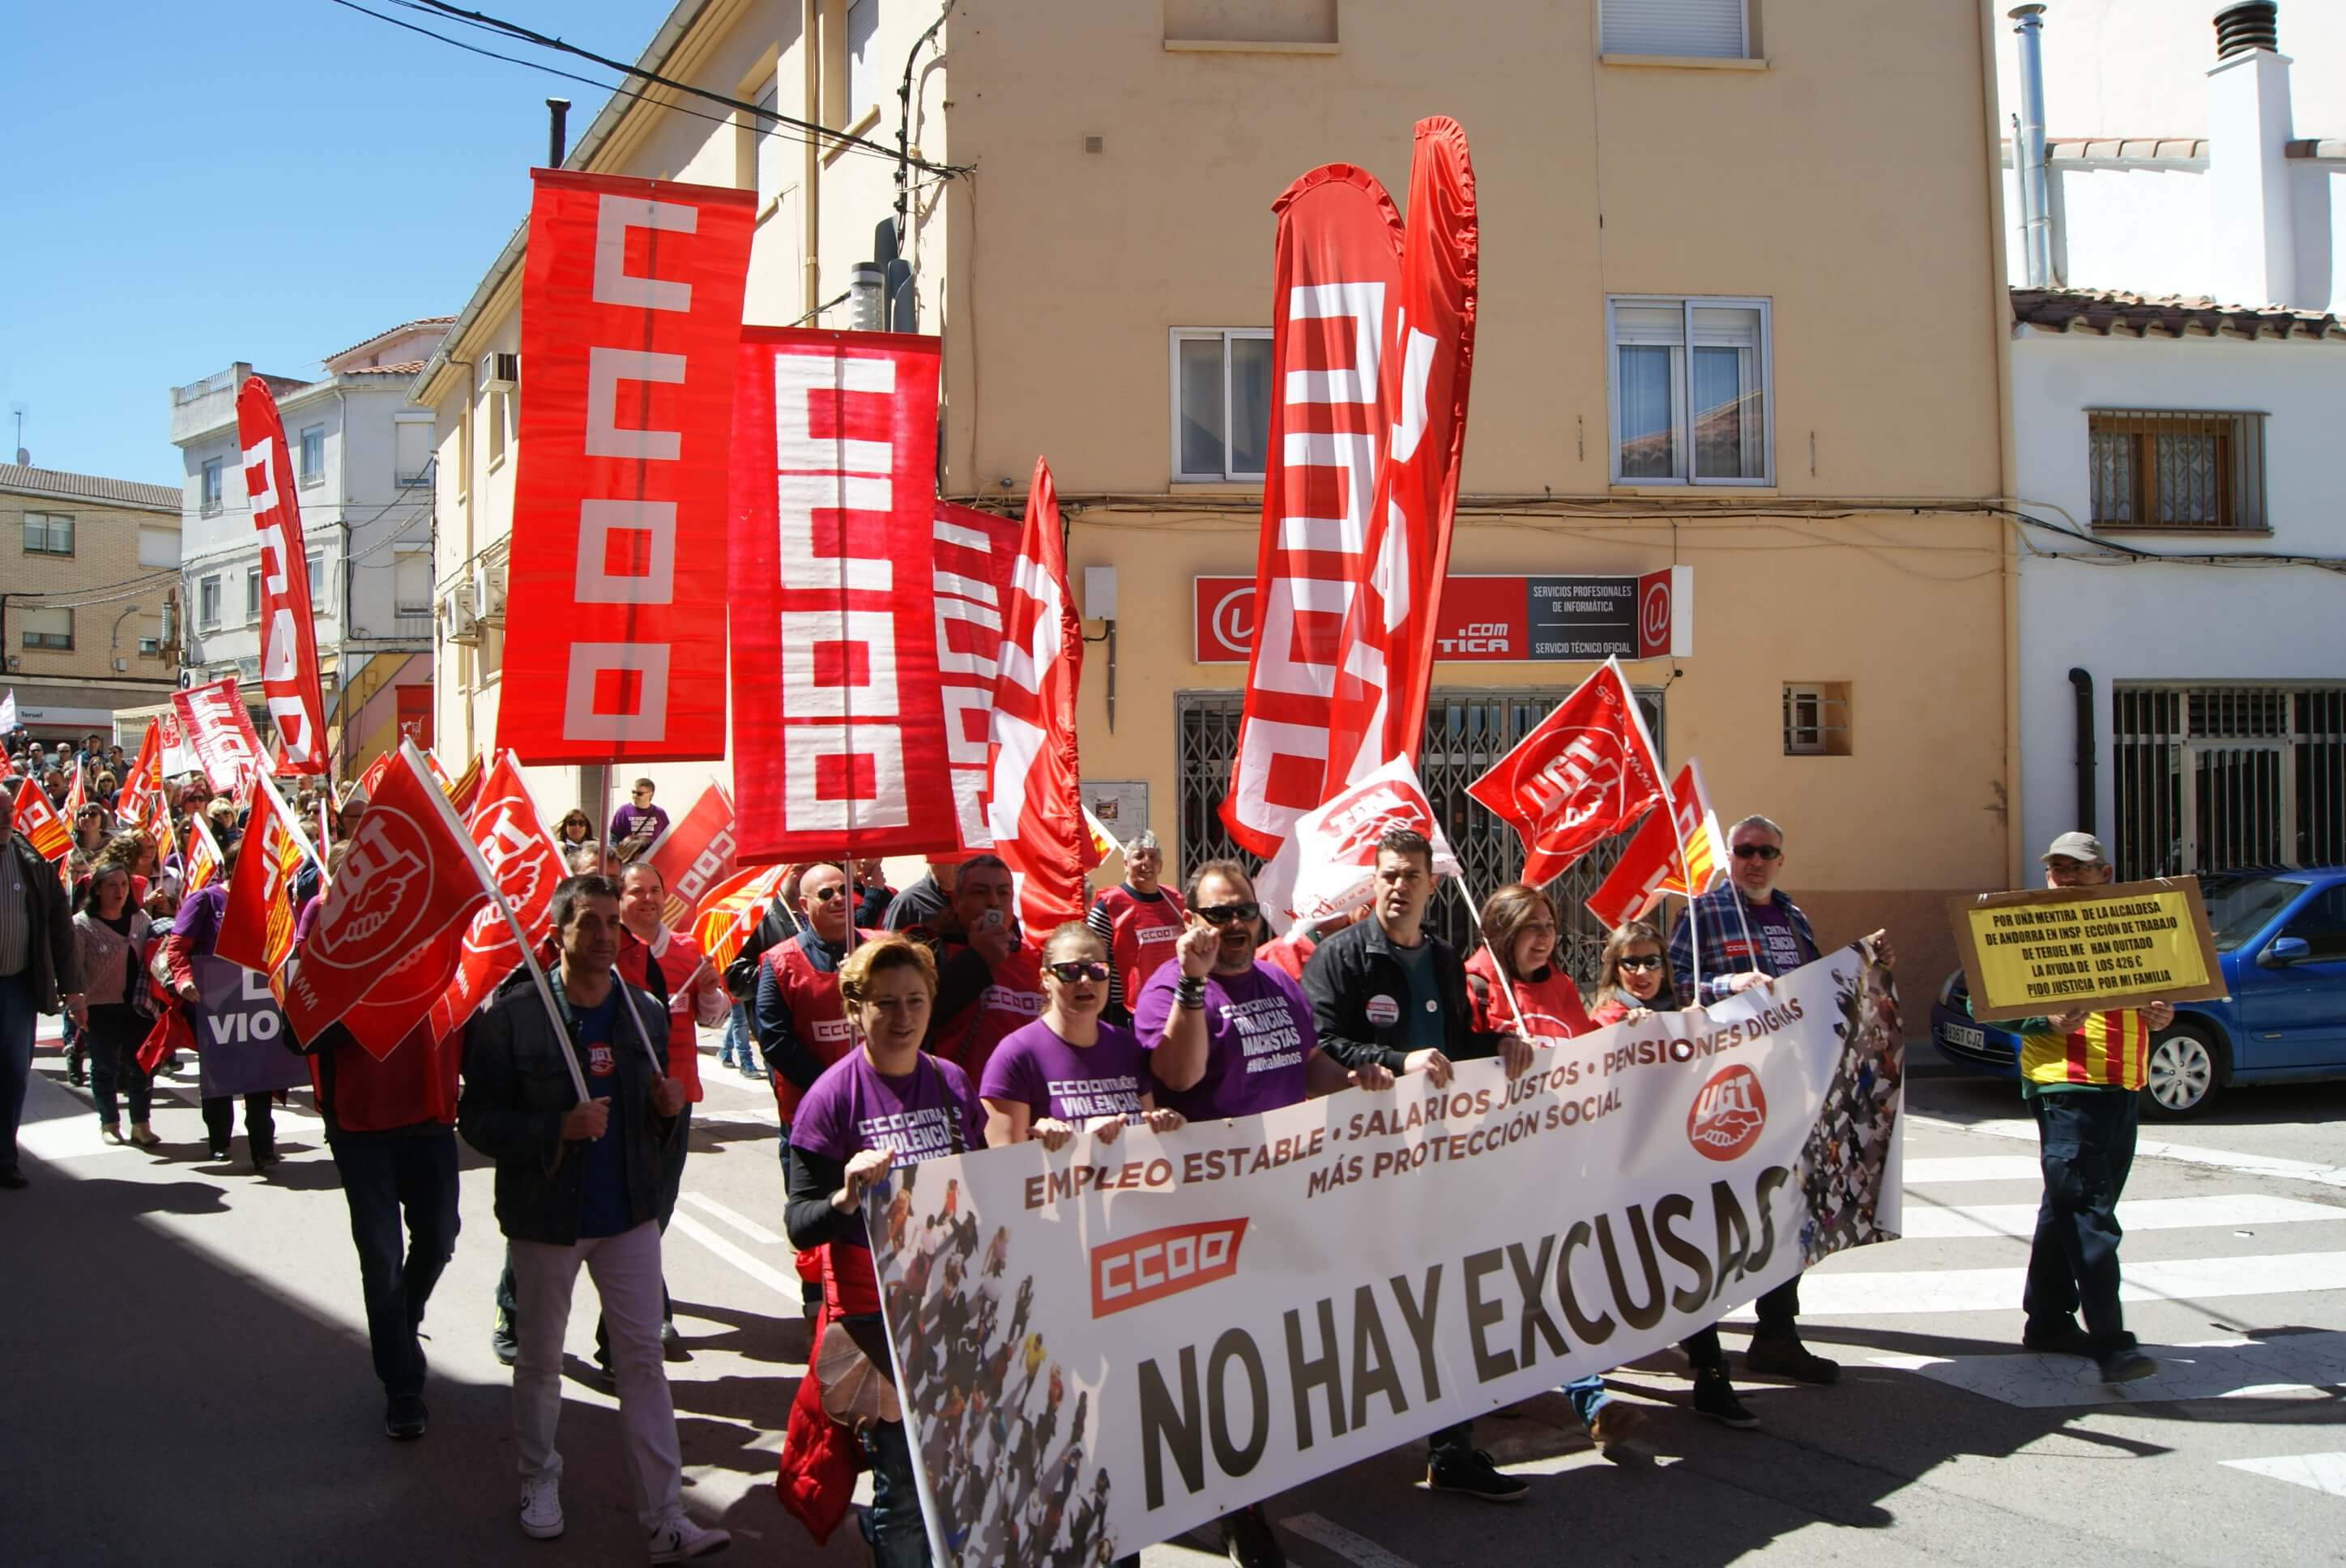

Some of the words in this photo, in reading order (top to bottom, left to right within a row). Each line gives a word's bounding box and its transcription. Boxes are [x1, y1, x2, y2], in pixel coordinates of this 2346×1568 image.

[565, 194, 698, 744] CCOO
[774, 354, 910, 832] CCOO
[1533, 586, 1572, 598] SERVICIOS
[1573, 585, 1632, 598] PROFESIONALES
[1552, 602, 1563, 612] DE
[1563, 599, 1614, 613] INFORMÁTICA
[1535, 642, 1569, 654] SERVICIO
[1570, 640, 1602, 654] TÉCNICO
[1603, 641, 1632, 654] OFICIAL
[1520, 735, 1601, 816] UGT
[477, 807, 537, 881] GT
[1993, 914, 2014, 928] POR
[2015, 912, 2034, 927] UNA
[2034, 909, 2078, 925] MENTIRA
[2082, 907, 2096, 921] DE
[2096, 906, 2109, 920] LA
[2109, 901, 2162, 919] ALCALDESA
[1141, 929, 1171, 940] CCOO
[1986, 933, 1999, 946] DE
[1999, 929, 2045, 945] ANDORRA
[2046, 927, 2058, 941] EN
[2058, 926, 2082, 940] INSP
[2084, 921, 2121, 938] ECCIÓN
[2122, 921, 2135, 935] DE
[2135, 916, 2178, 932] TRABAJO
[2022, 948, 2034, 961] DE
[2034, 944, 2069, 960] TERUEL
[2071, 942, 2085, 957] ME
[2091, 940, 2111, 955] HAN
[2113, 936, 2154, 953] QUITADO
[2032, 964, 2045, 978] LA
[2045, 961, 2075, 977] AYUDA
[2076, 961, 2090, 974] DE
[2096, 957, 2114, 972] LOS
[2116, 956, 2135, 970] 426
[2027, 982, 2050, 996] PIDO
[2051, 978, 2095, 995] JUSTICIA
[2099, 975, 2119, 990] POR
[2120, 974, 2133, 987] MI
[2134, 969, 2172, 986] FAMILIA
[987, 991, 1034, 1011] CCOO
[1024, 1158, 1172, 1210] EMPLEO
[1181, 1127, 1324, 1184] ESTABLE
[1347, 1089, 1491, 1143] SALARIOS
[1497, 1059, 1580, 1113] JUSTOS
[1602, 1023, 1744, 1075] PENSIONES
[1747, 997, 1805, 1043] DIGNAS
[1696, 1073, 1754, 1125] UGT
[1306, 1155, 1364, 1199] MÁS
[1371, 1111, 1541, 1180] PROTECCIÓN
[1543, 1086, 1623, 1131] SOCIAL
[1101, 1229, 1235, 1301] CCOO
[1137, 1326, 1270, 1512] NO
[1282, 1263, 1444, 1452] HAY
[1462, 1165, 1790, 1384] EXCUSAS
